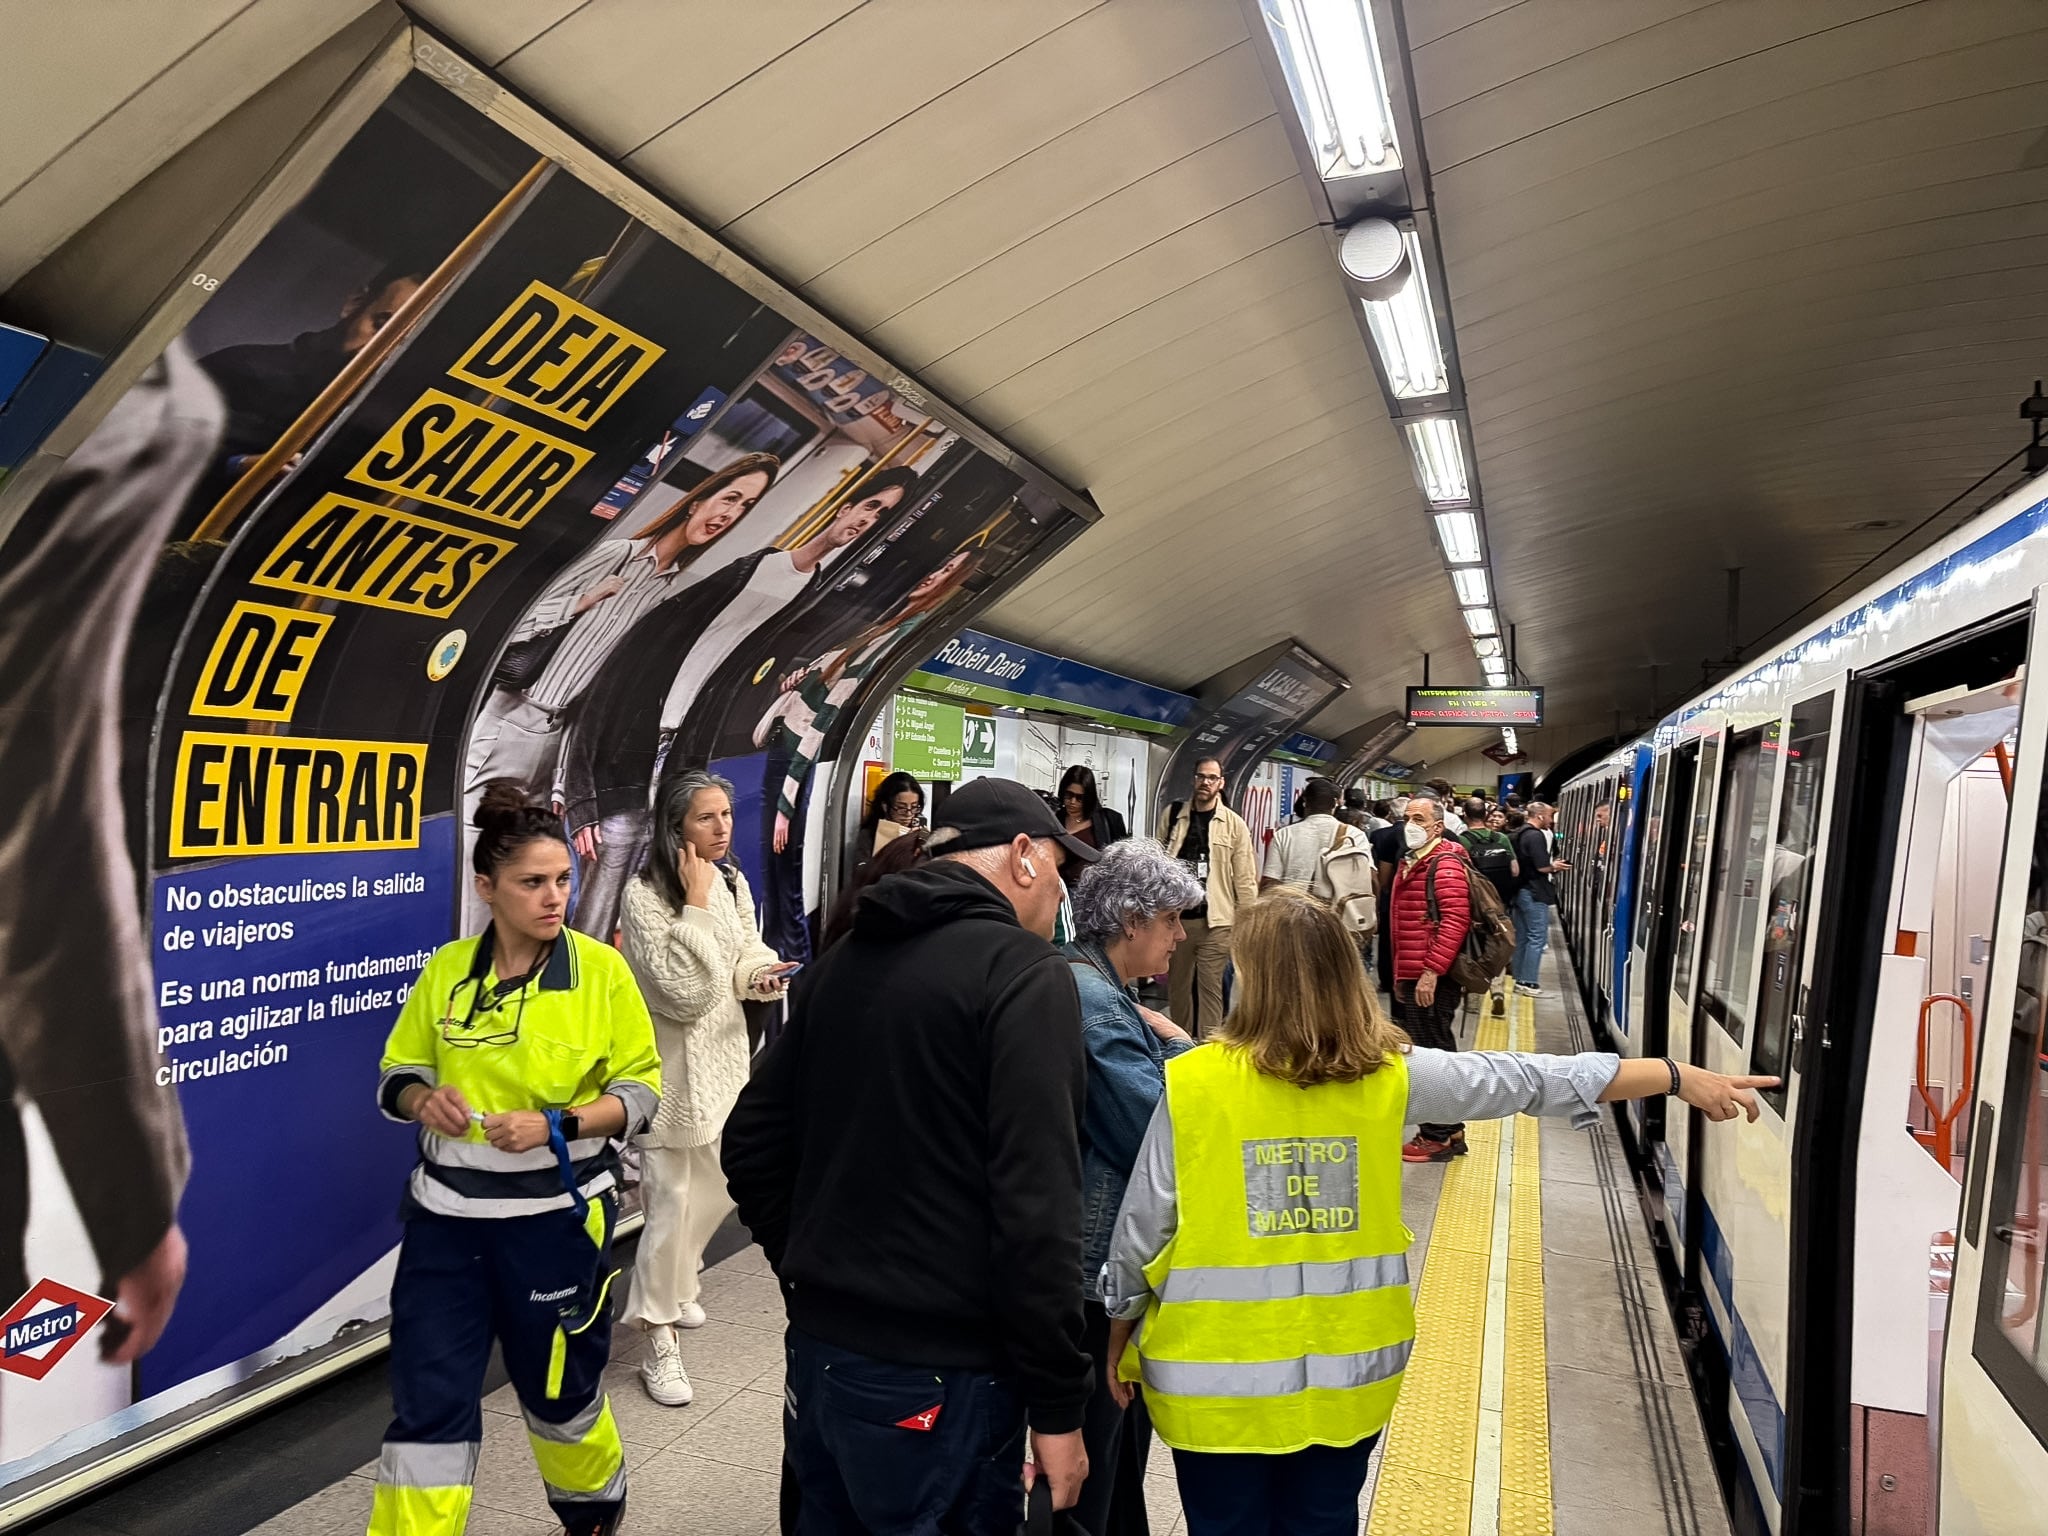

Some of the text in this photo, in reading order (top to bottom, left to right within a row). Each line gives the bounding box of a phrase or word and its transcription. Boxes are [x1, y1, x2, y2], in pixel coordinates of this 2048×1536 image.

[192, 273, 219, 291] 08
[462, 293, 646, 421] DEJA
[366, 403, 575, 521] SALIR
[263, 504, 499, 609] ANTES
[204, 611, 321, 712] DE
[934, 638, 1026, 680] Rubén Darío
[967, 686, 978, 696] 2
[182, 743, 418, 847] ENTRAR
[166, 872, 425, 911] No obstaculices la salida
[163, 920, 294, 951] de viajeros
[160, 981, 193, 1007] Es
[201, 982, 245, 1002] una
[252, 967, 320, 994] norma
[158, 1019, 213, 1053] para
[220, 1005, 302, 1040] agilizar
[307, 998, 325, 1022] la
[330, 988, 392, 1017] fluidez
[155, 1040, 288, 1087] circulación
[1255, 1141, 1348, 1165] METRO
[1286, 1175, 1320, 1197] DE
[1254, 1206, 1354, 1232] MADRID
[10, 1315, 73, 1349] Metro
